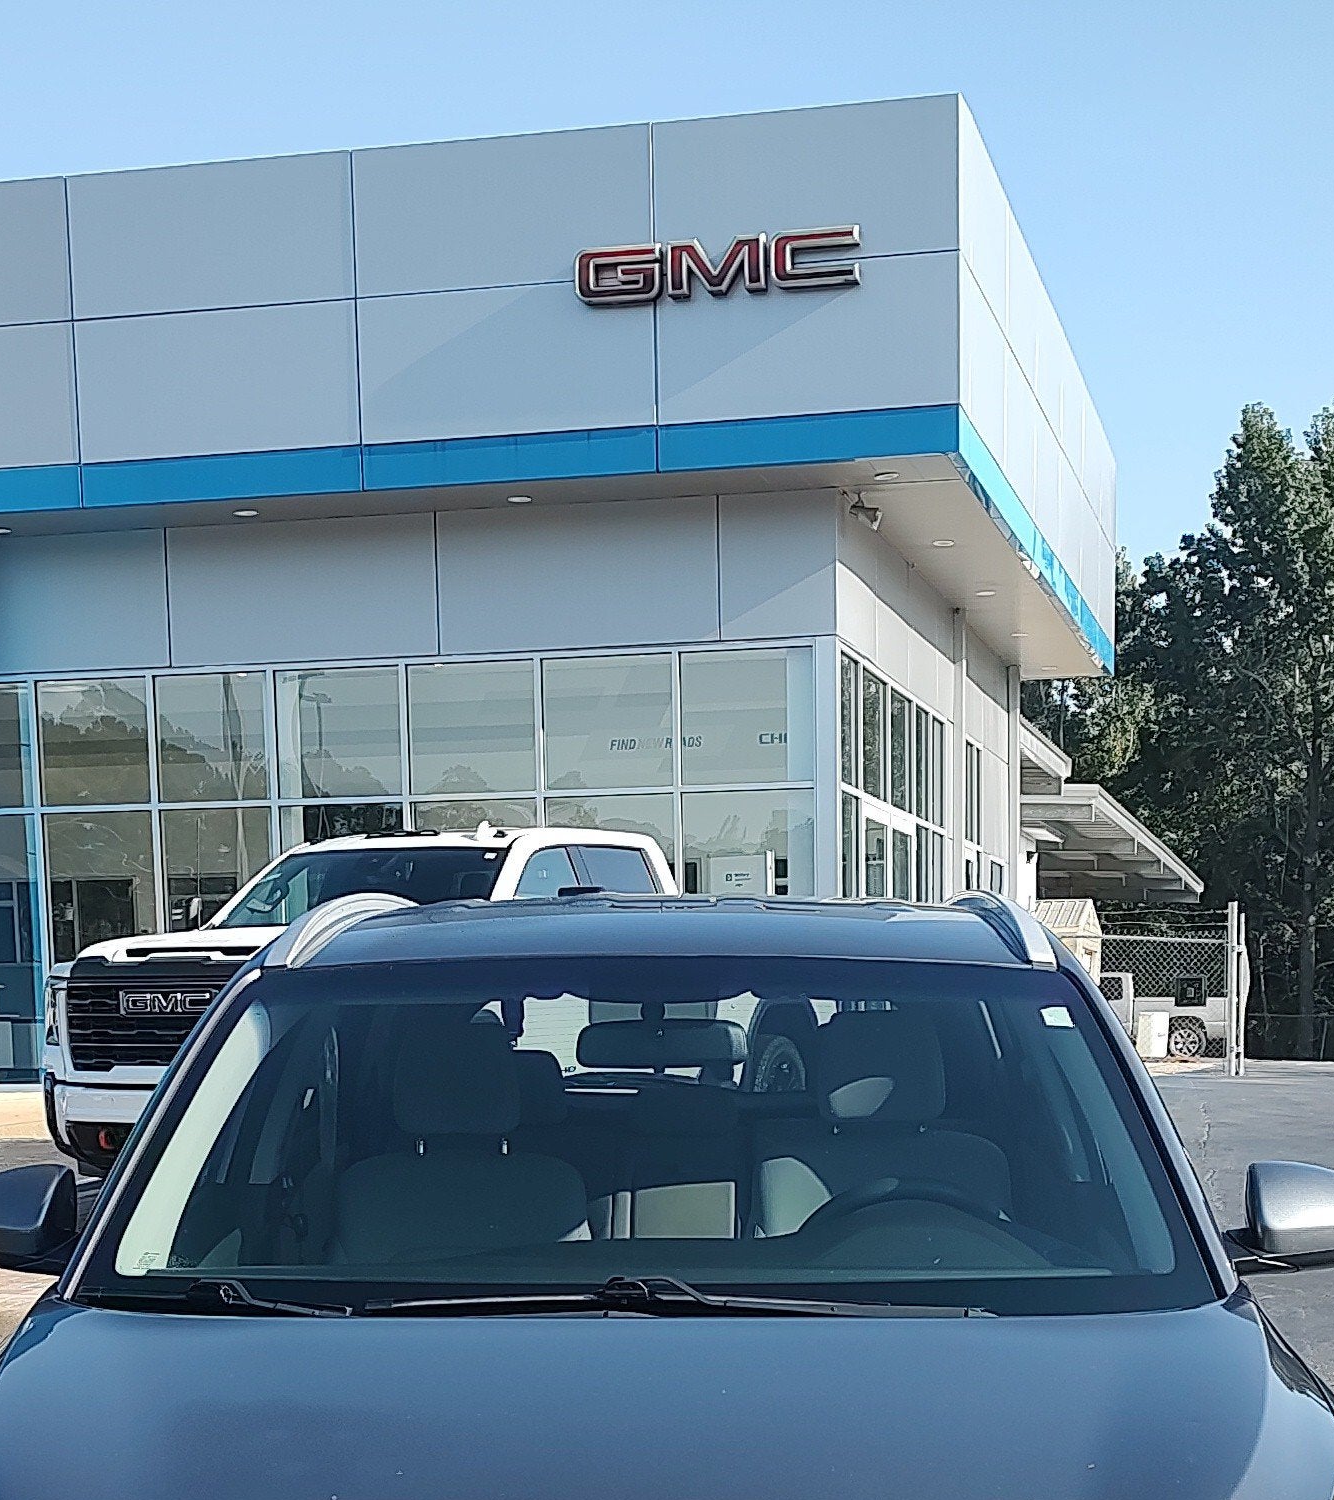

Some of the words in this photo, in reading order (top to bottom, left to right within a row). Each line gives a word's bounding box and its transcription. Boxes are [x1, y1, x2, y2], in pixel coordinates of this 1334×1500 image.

[574, 224, 860, 306] GMC
[610, 739, 637, 751] FIND
[665, 736, 702, 749] RADS
[124, 993, 210, 1012] GMC
